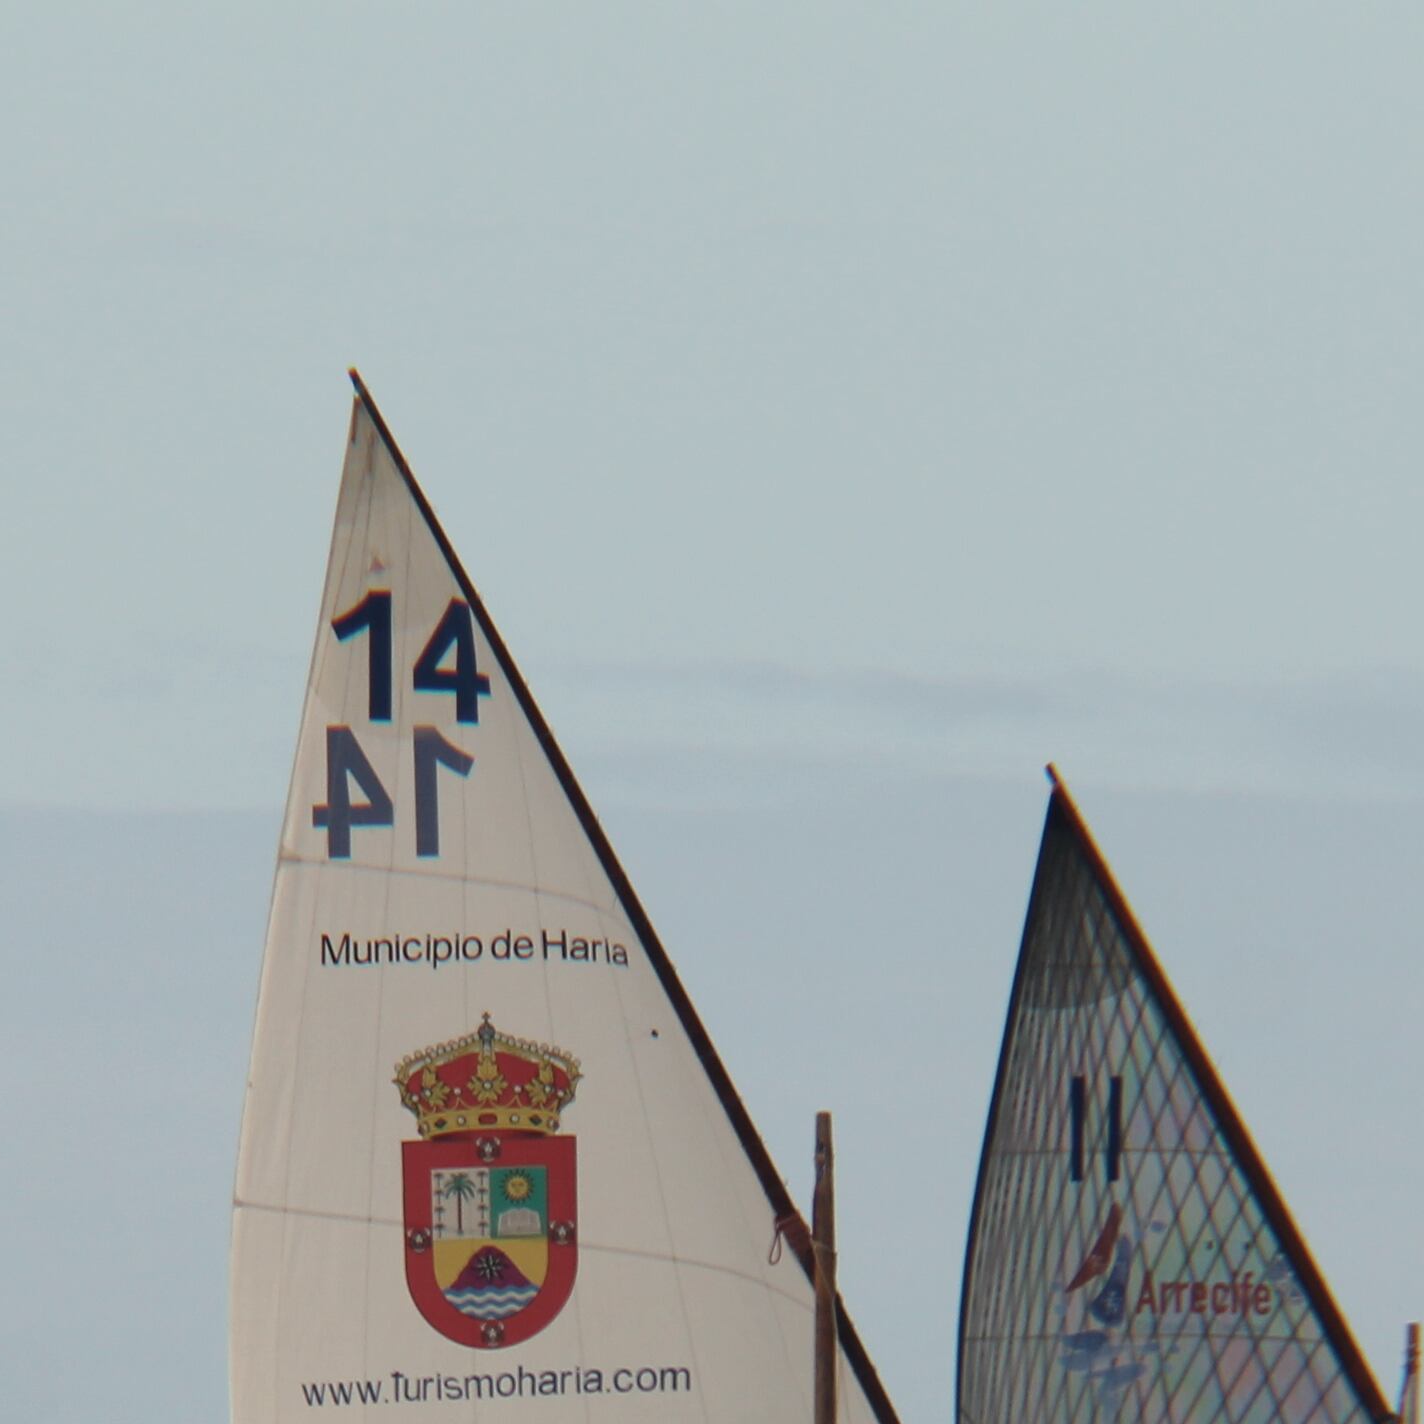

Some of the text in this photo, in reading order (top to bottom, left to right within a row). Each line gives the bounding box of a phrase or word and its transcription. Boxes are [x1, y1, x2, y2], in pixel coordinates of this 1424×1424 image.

[332, 588, 492, 726] 14
[320, 931, 484, 970] Municipio
[490, 929, 535, 961] de
[1135, 1269, 1274, 1317] Arrecife
